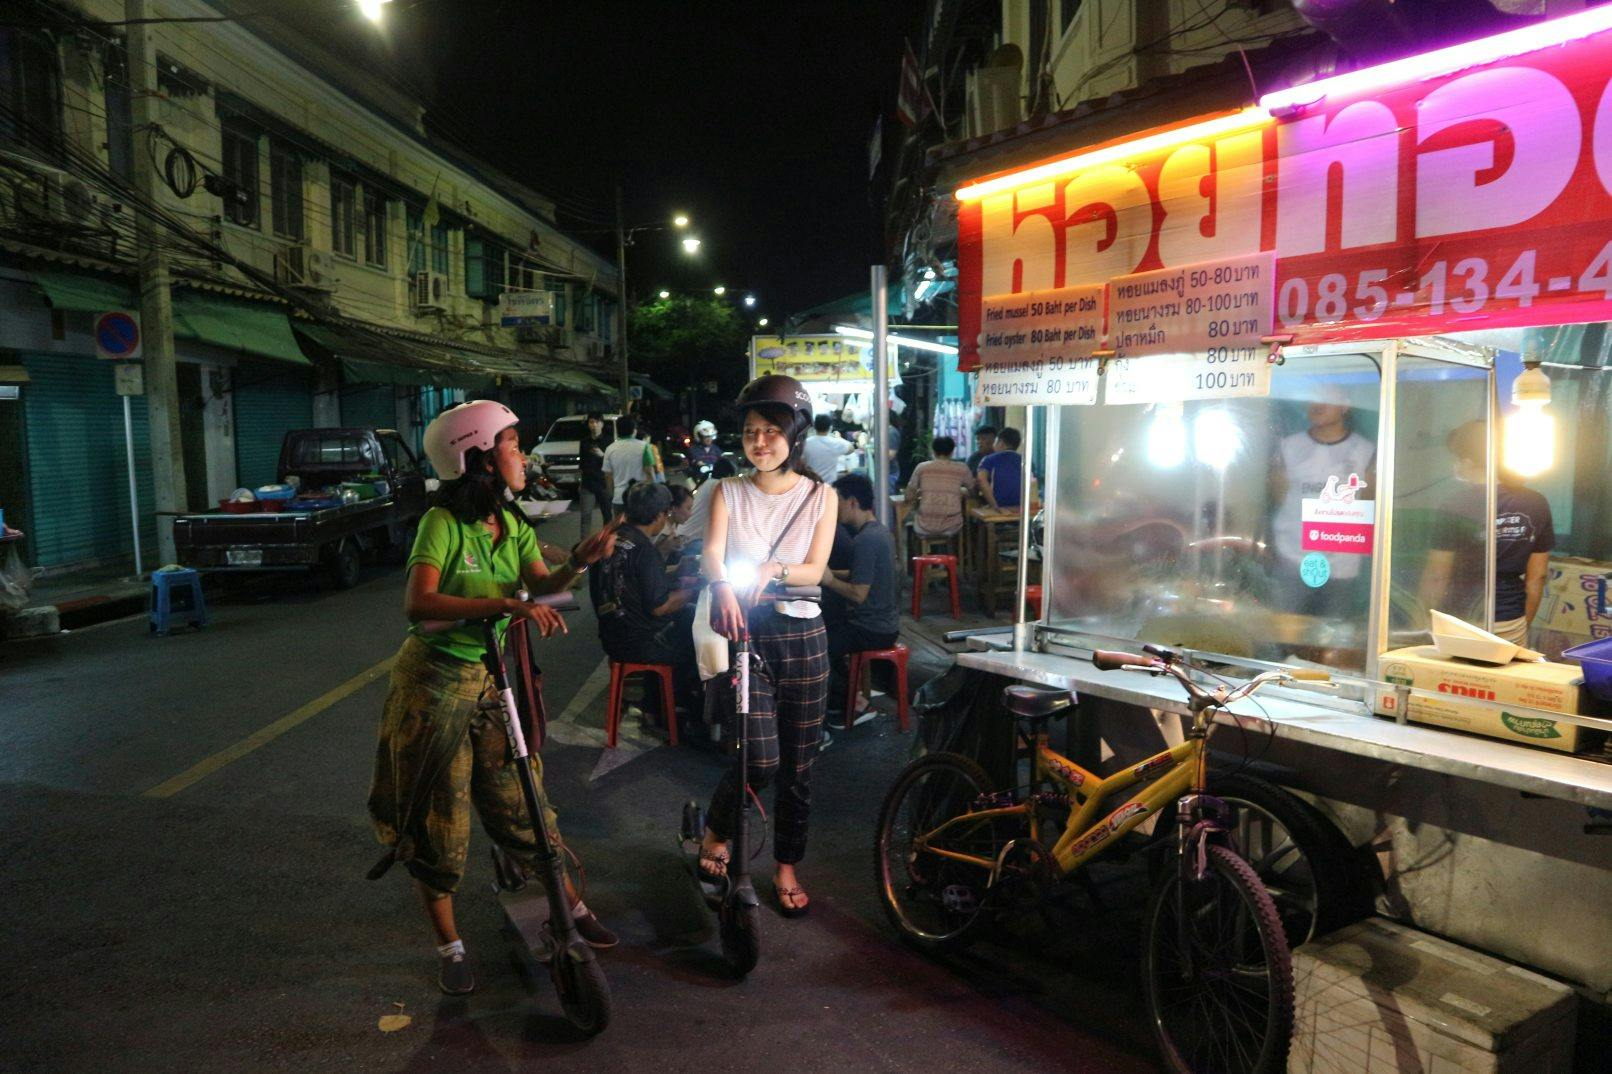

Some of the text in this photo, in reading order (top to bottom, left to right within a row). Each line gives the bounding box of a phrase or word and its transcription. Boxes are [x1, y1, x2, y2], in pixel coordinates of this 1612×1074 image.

[981, 66, 1612, 296] หอยทอ
[987, 296, 1097, 320] Fried mussel 50 Baht per Dish
[1116, 302, 1182, 324] หอยนางรม
[986, 325, 1096, 348] Fried oyster 80 Baht per Dish
[1208, 320, 1229, 338] 80
[1232, 319, 1258, 336] บาท
[1049, 356, 1064, 371] 50
[1069, 355, 1093, 370] บาท
[1207, 346, 1228, 364] 80
[1231, 345, 1256, 363] บาท
[1046, 379, 1062, 394] 80
[1196, 371, 1255, 390] 100 บาท
[1320, 531, 1366, 544] foodpanda
